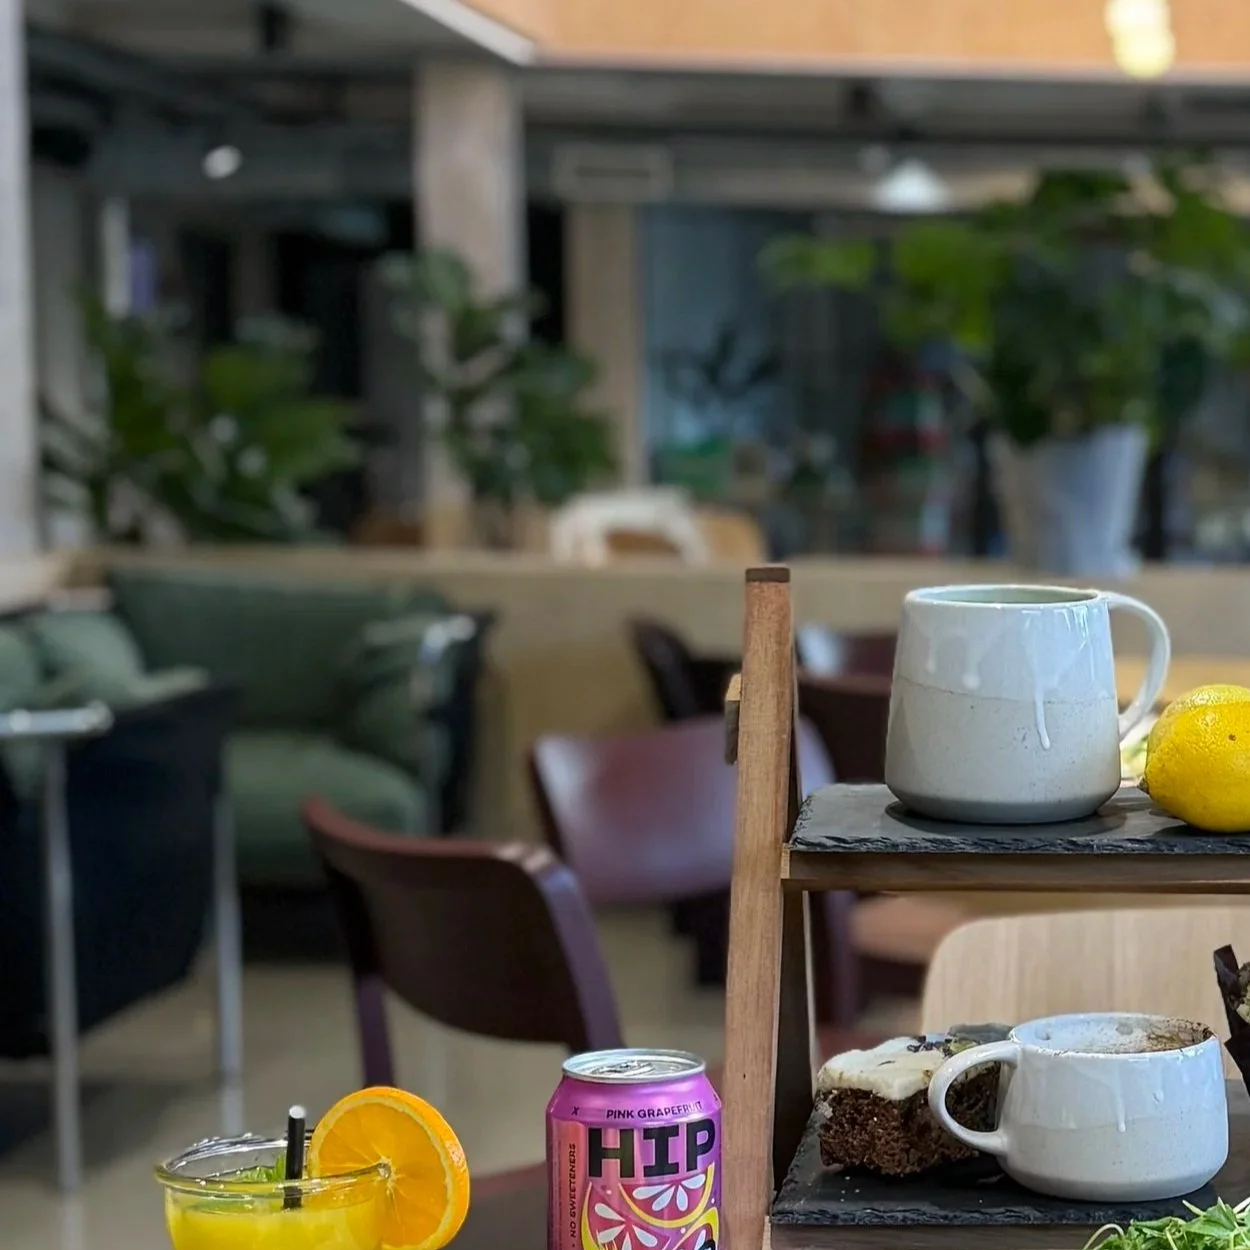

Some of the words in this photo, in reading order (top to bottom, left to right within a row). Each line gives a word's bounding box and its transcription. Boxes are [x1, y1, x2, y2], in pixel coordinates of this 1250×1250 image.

[606, 1109, 634, 1119] PINK
[637, 1101, 702, 1119] GRAPEFRUIT
[588, 1119, 715, 1178] HIP
[569, 1143, 577, 1218] SWEETENERS
[570, 1221, 577, 1238] NO
